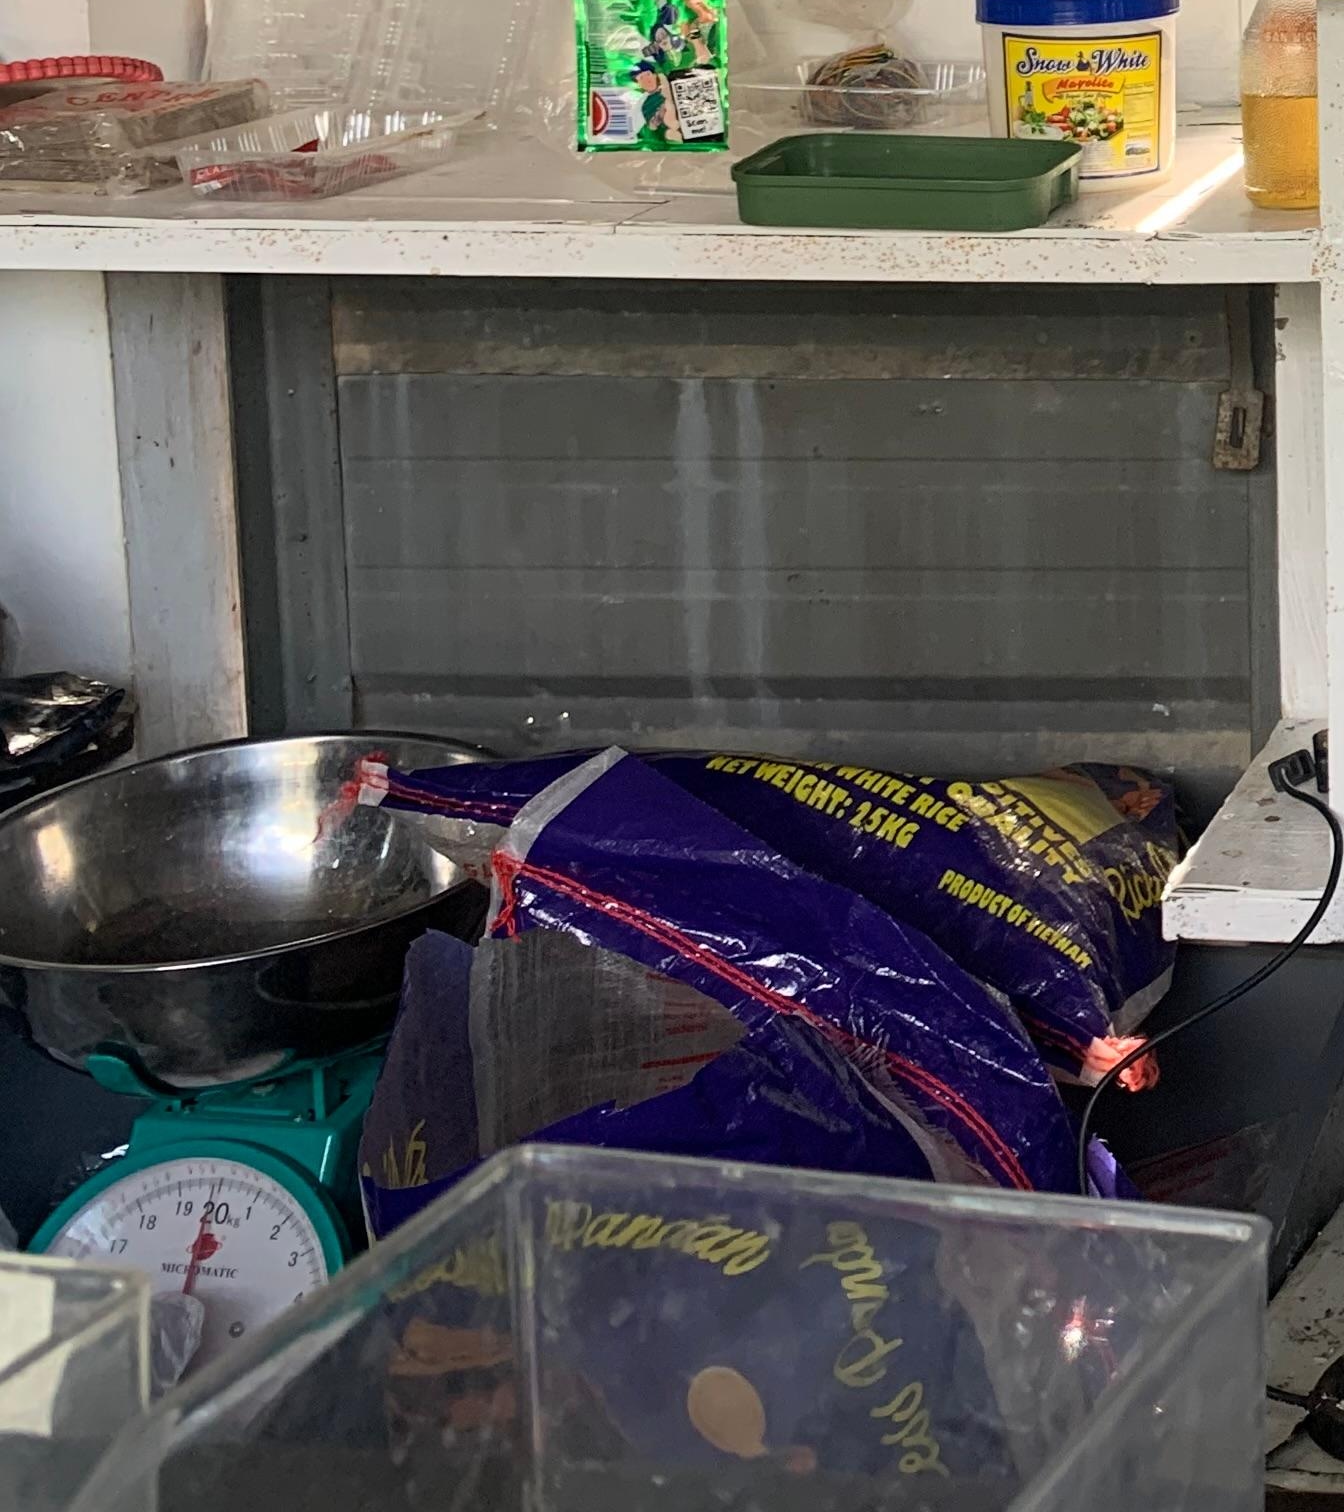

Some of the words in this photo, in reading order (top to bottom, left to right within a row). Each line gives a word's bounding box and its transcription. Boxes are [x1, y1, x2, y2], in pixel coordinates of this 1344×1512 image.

[1016, 46, 1072, 78] Snow
[1091, 47, 1150, 75] White
[705, 753, 758, 775] NET
[848, 801, 921, 850] 25KG
[836, 765, 917, 807] WHITE
[909, 792, 971, 834] RICE
[937, 869, 1012, 919] PRODUCT
[1005, 901, 1032, 928] OF
[1024, 915, 1093, 970] VIETNAM
[174, 1200, 194, 1218] 19
[199, 1201, 230, 1226] 20
[244, 1205, 252, 1221] 1
[138, 1213, 158, 1231] 18
[269, 1224, 282, 1241] 2
[108, 1238, 129, 1256] 17
[287, 1251, 299, 1268] 3
